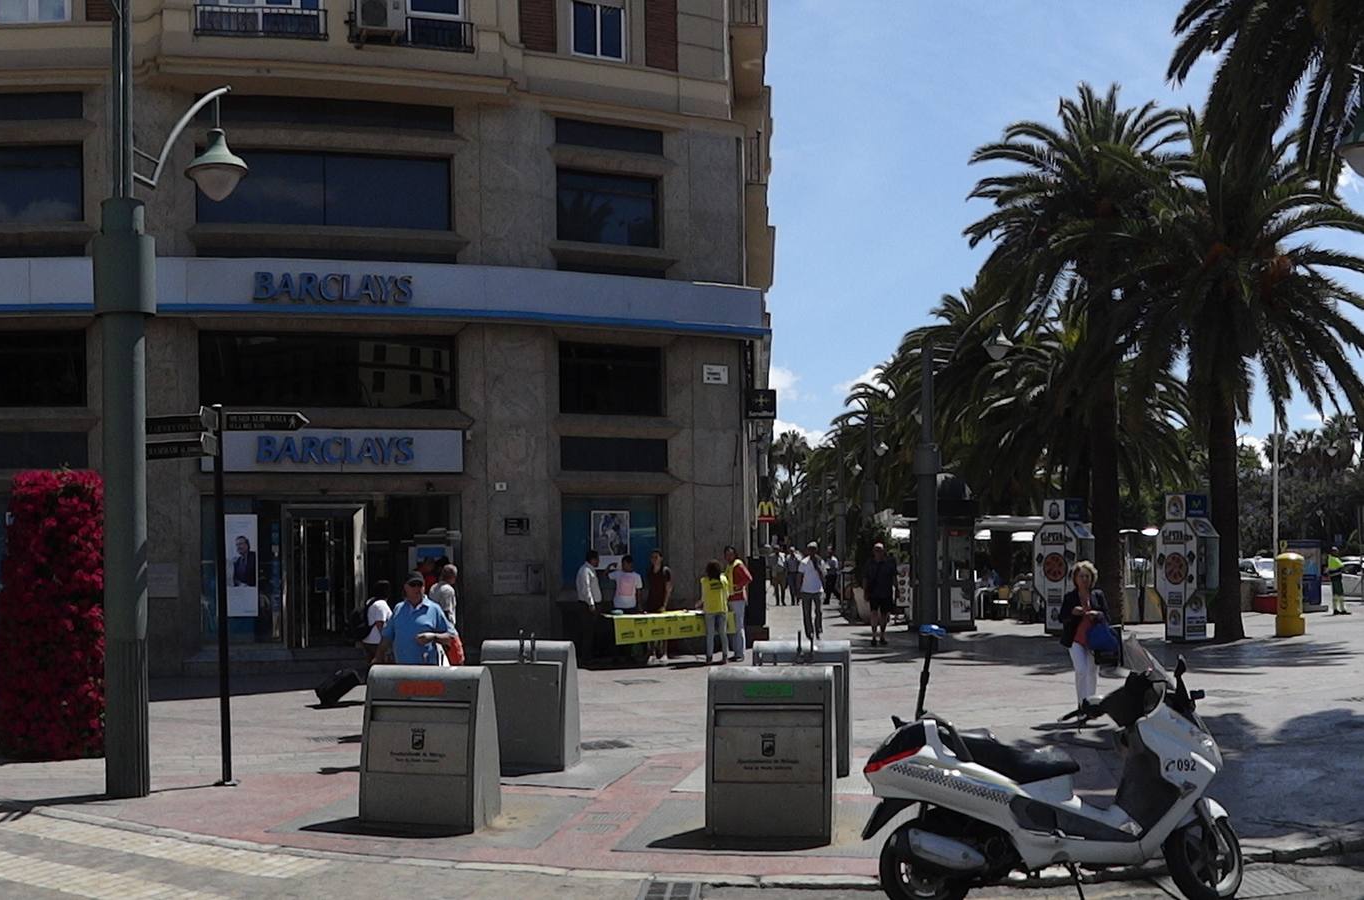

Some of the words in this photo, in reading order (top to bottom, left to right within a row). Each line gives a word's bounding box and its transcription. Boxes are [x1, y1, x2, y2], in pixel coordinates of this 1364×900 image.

[253, 271, 414, 304] BARCLAYS
[256, 435, 415, 465] BARCLAYS
[1177, 758, 1196, 772] 092
